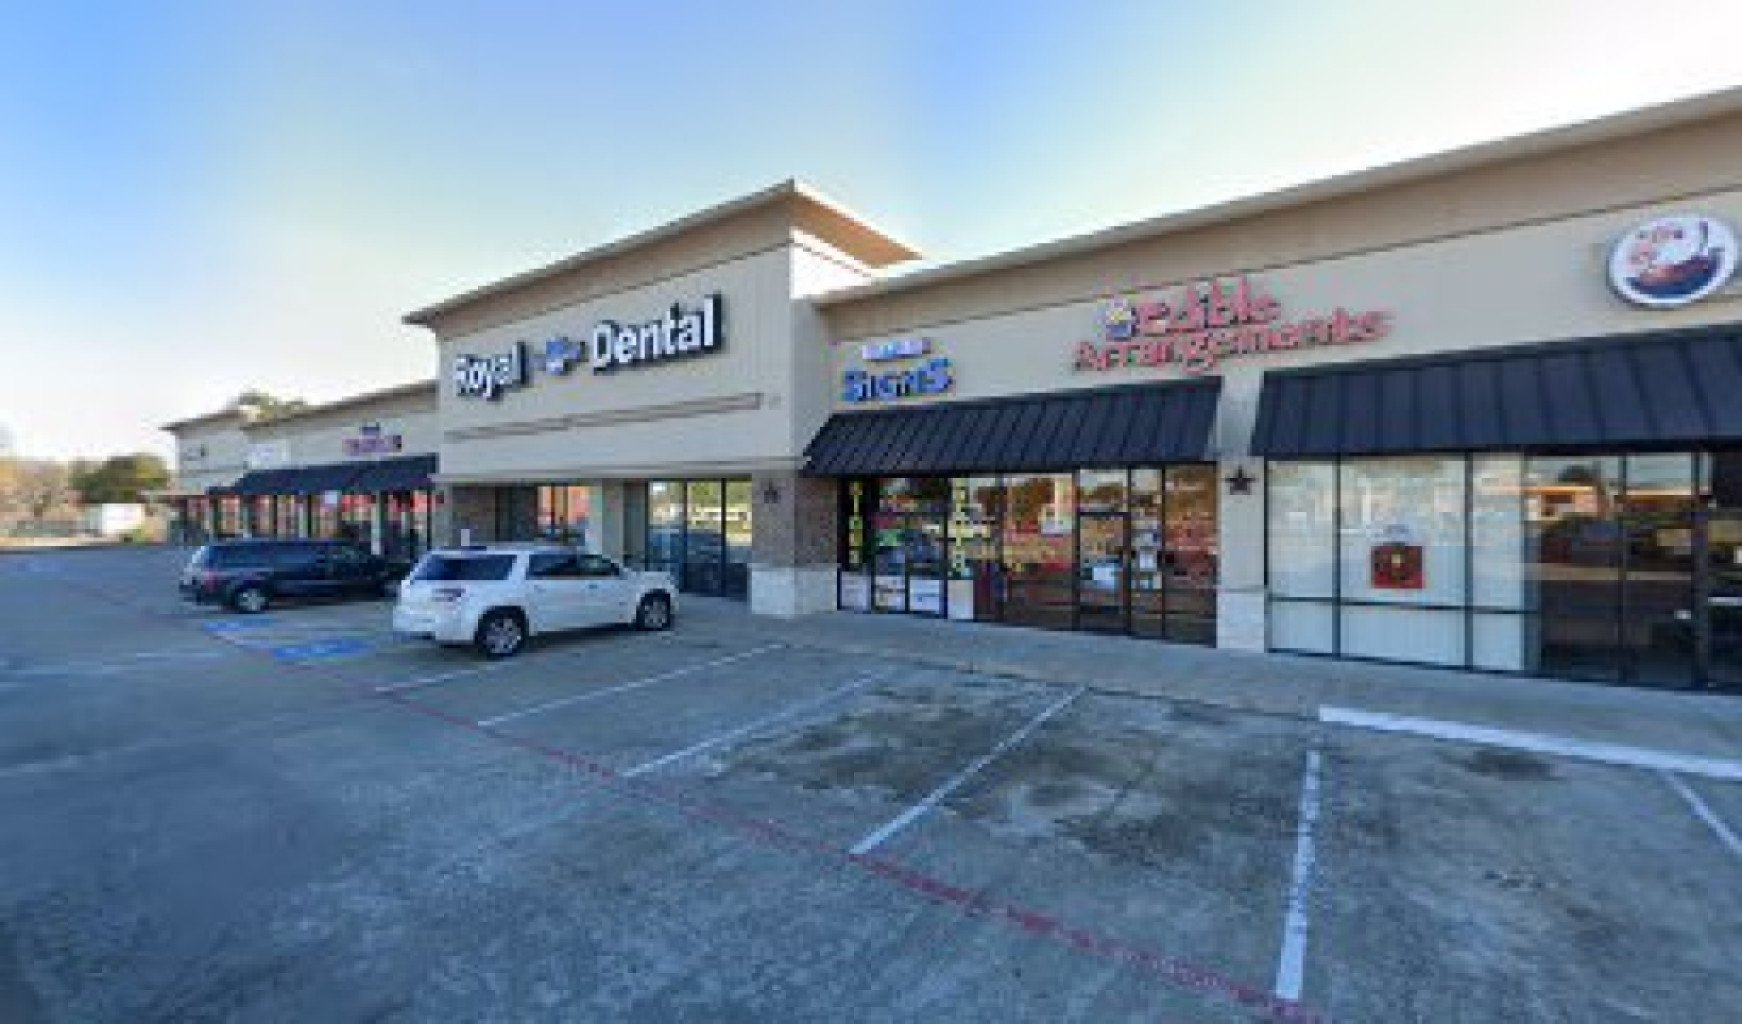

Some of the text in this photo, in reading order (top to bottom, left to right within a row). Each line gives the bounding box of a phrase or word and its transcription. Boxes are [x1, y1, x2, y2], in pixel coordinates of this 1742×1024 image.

[1137, 276, 1281, 334] Edible
[456, 293, 721, 398] Royal Dental
[1073, 307, 1394, 374] Arrangements
